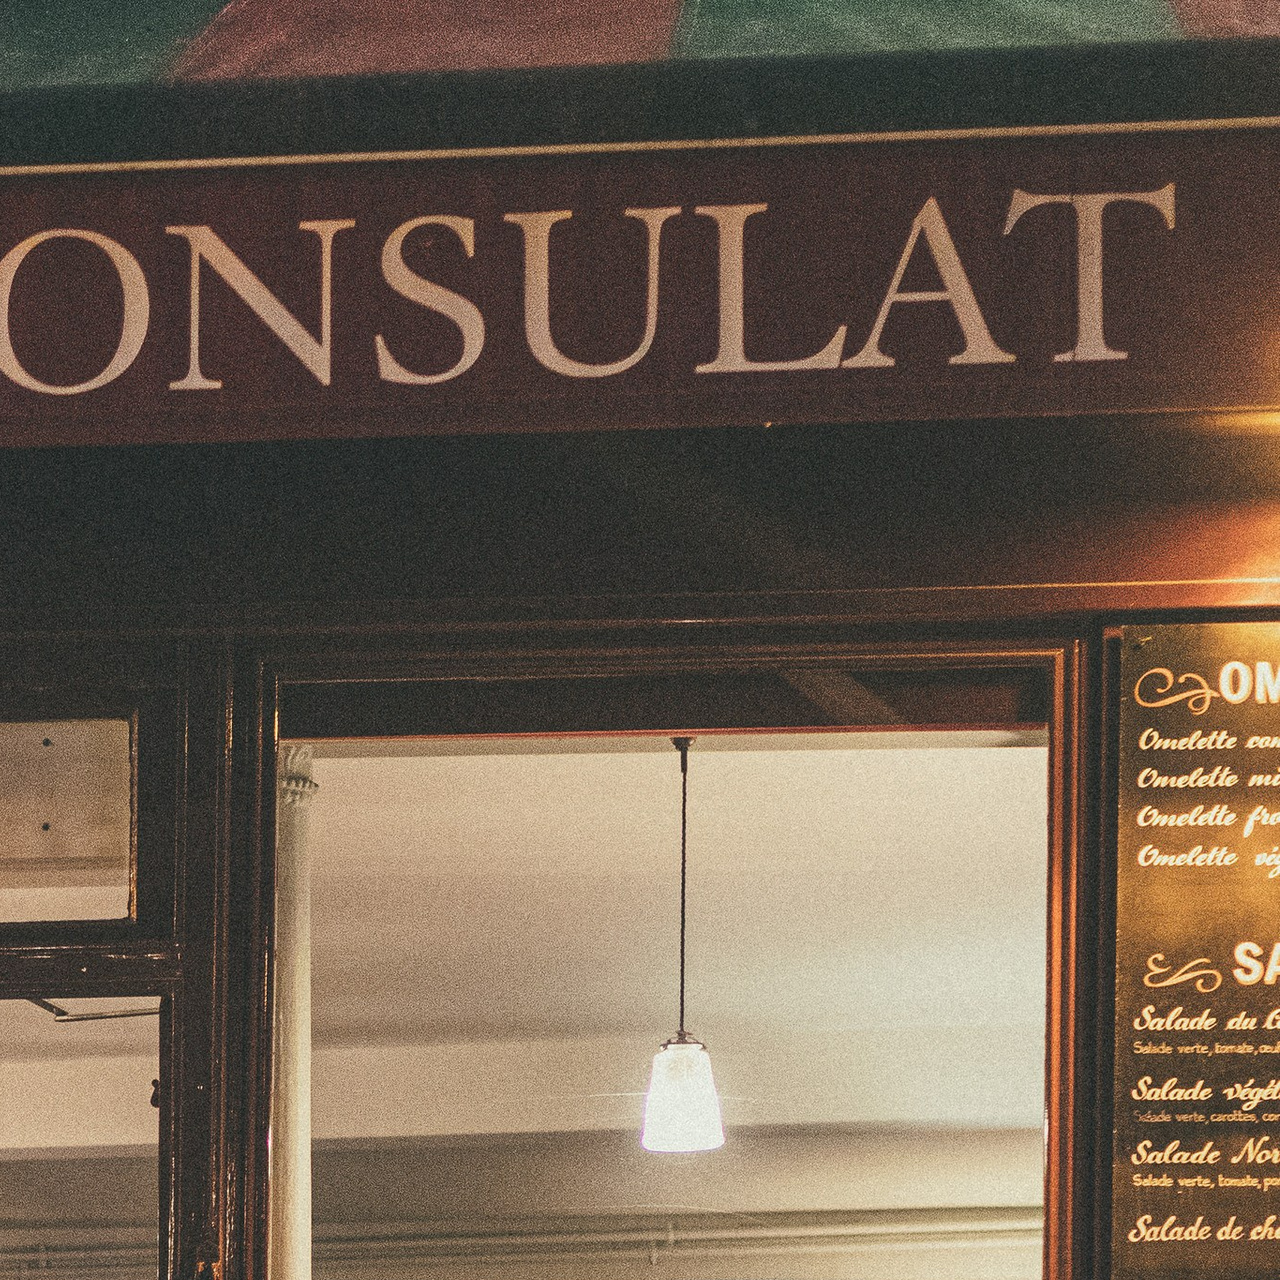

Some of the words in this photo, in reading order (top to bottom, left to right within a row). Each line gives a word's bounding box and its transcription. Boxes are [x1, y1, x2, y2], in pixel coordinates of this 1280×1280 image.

[1139, 727, 1238, 751] Omelette
[1137, 766, 1240, 789] Omelette
[1137, 804, 1239, 827] Omelette
[1138, 844, 1239, 867] Omelette
[1133, 1004, 1218, 1031] Salade
[1224, 1010, 1258, 1031] du
[1131, 1075, 1214, 1101] Salade
[1131, 1139, 1221, 1165] Salade
[1132, 1173, 1174, 1187] Salade
[1127, 1214, 1212, 1243] Salade
[1216, 1215, 1245, 1241] de
